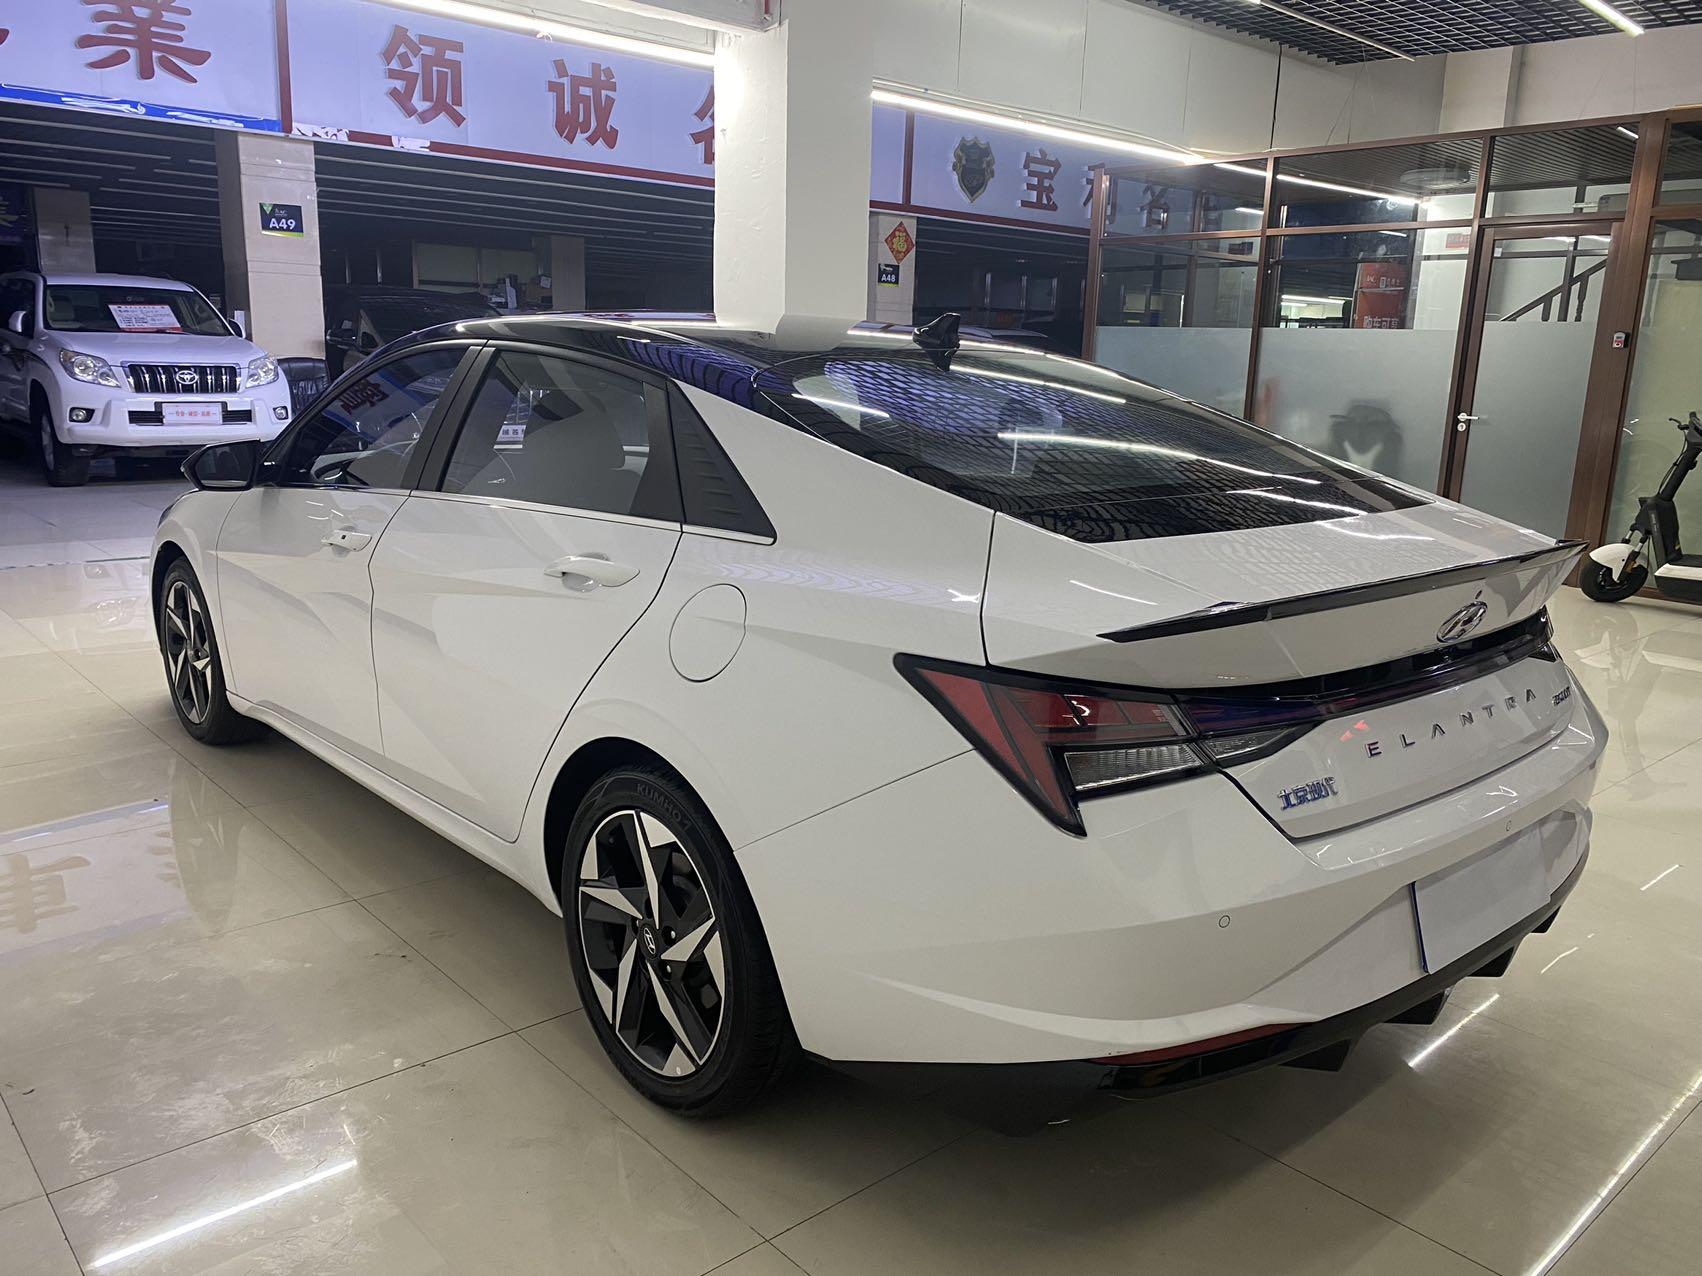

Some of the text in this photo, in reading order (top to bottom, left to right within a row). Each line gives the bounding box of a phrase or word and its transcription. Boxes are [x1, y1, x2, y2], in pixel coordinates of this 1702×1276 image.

[269, 218, 296, 230] A49
[881, 274, 896, 282] A48
[1364, 688, 1537, 758] ELANTRA
[637, 783, 682, 823] KUMHO
[1277, 776, 1339, 811] 北京现代
